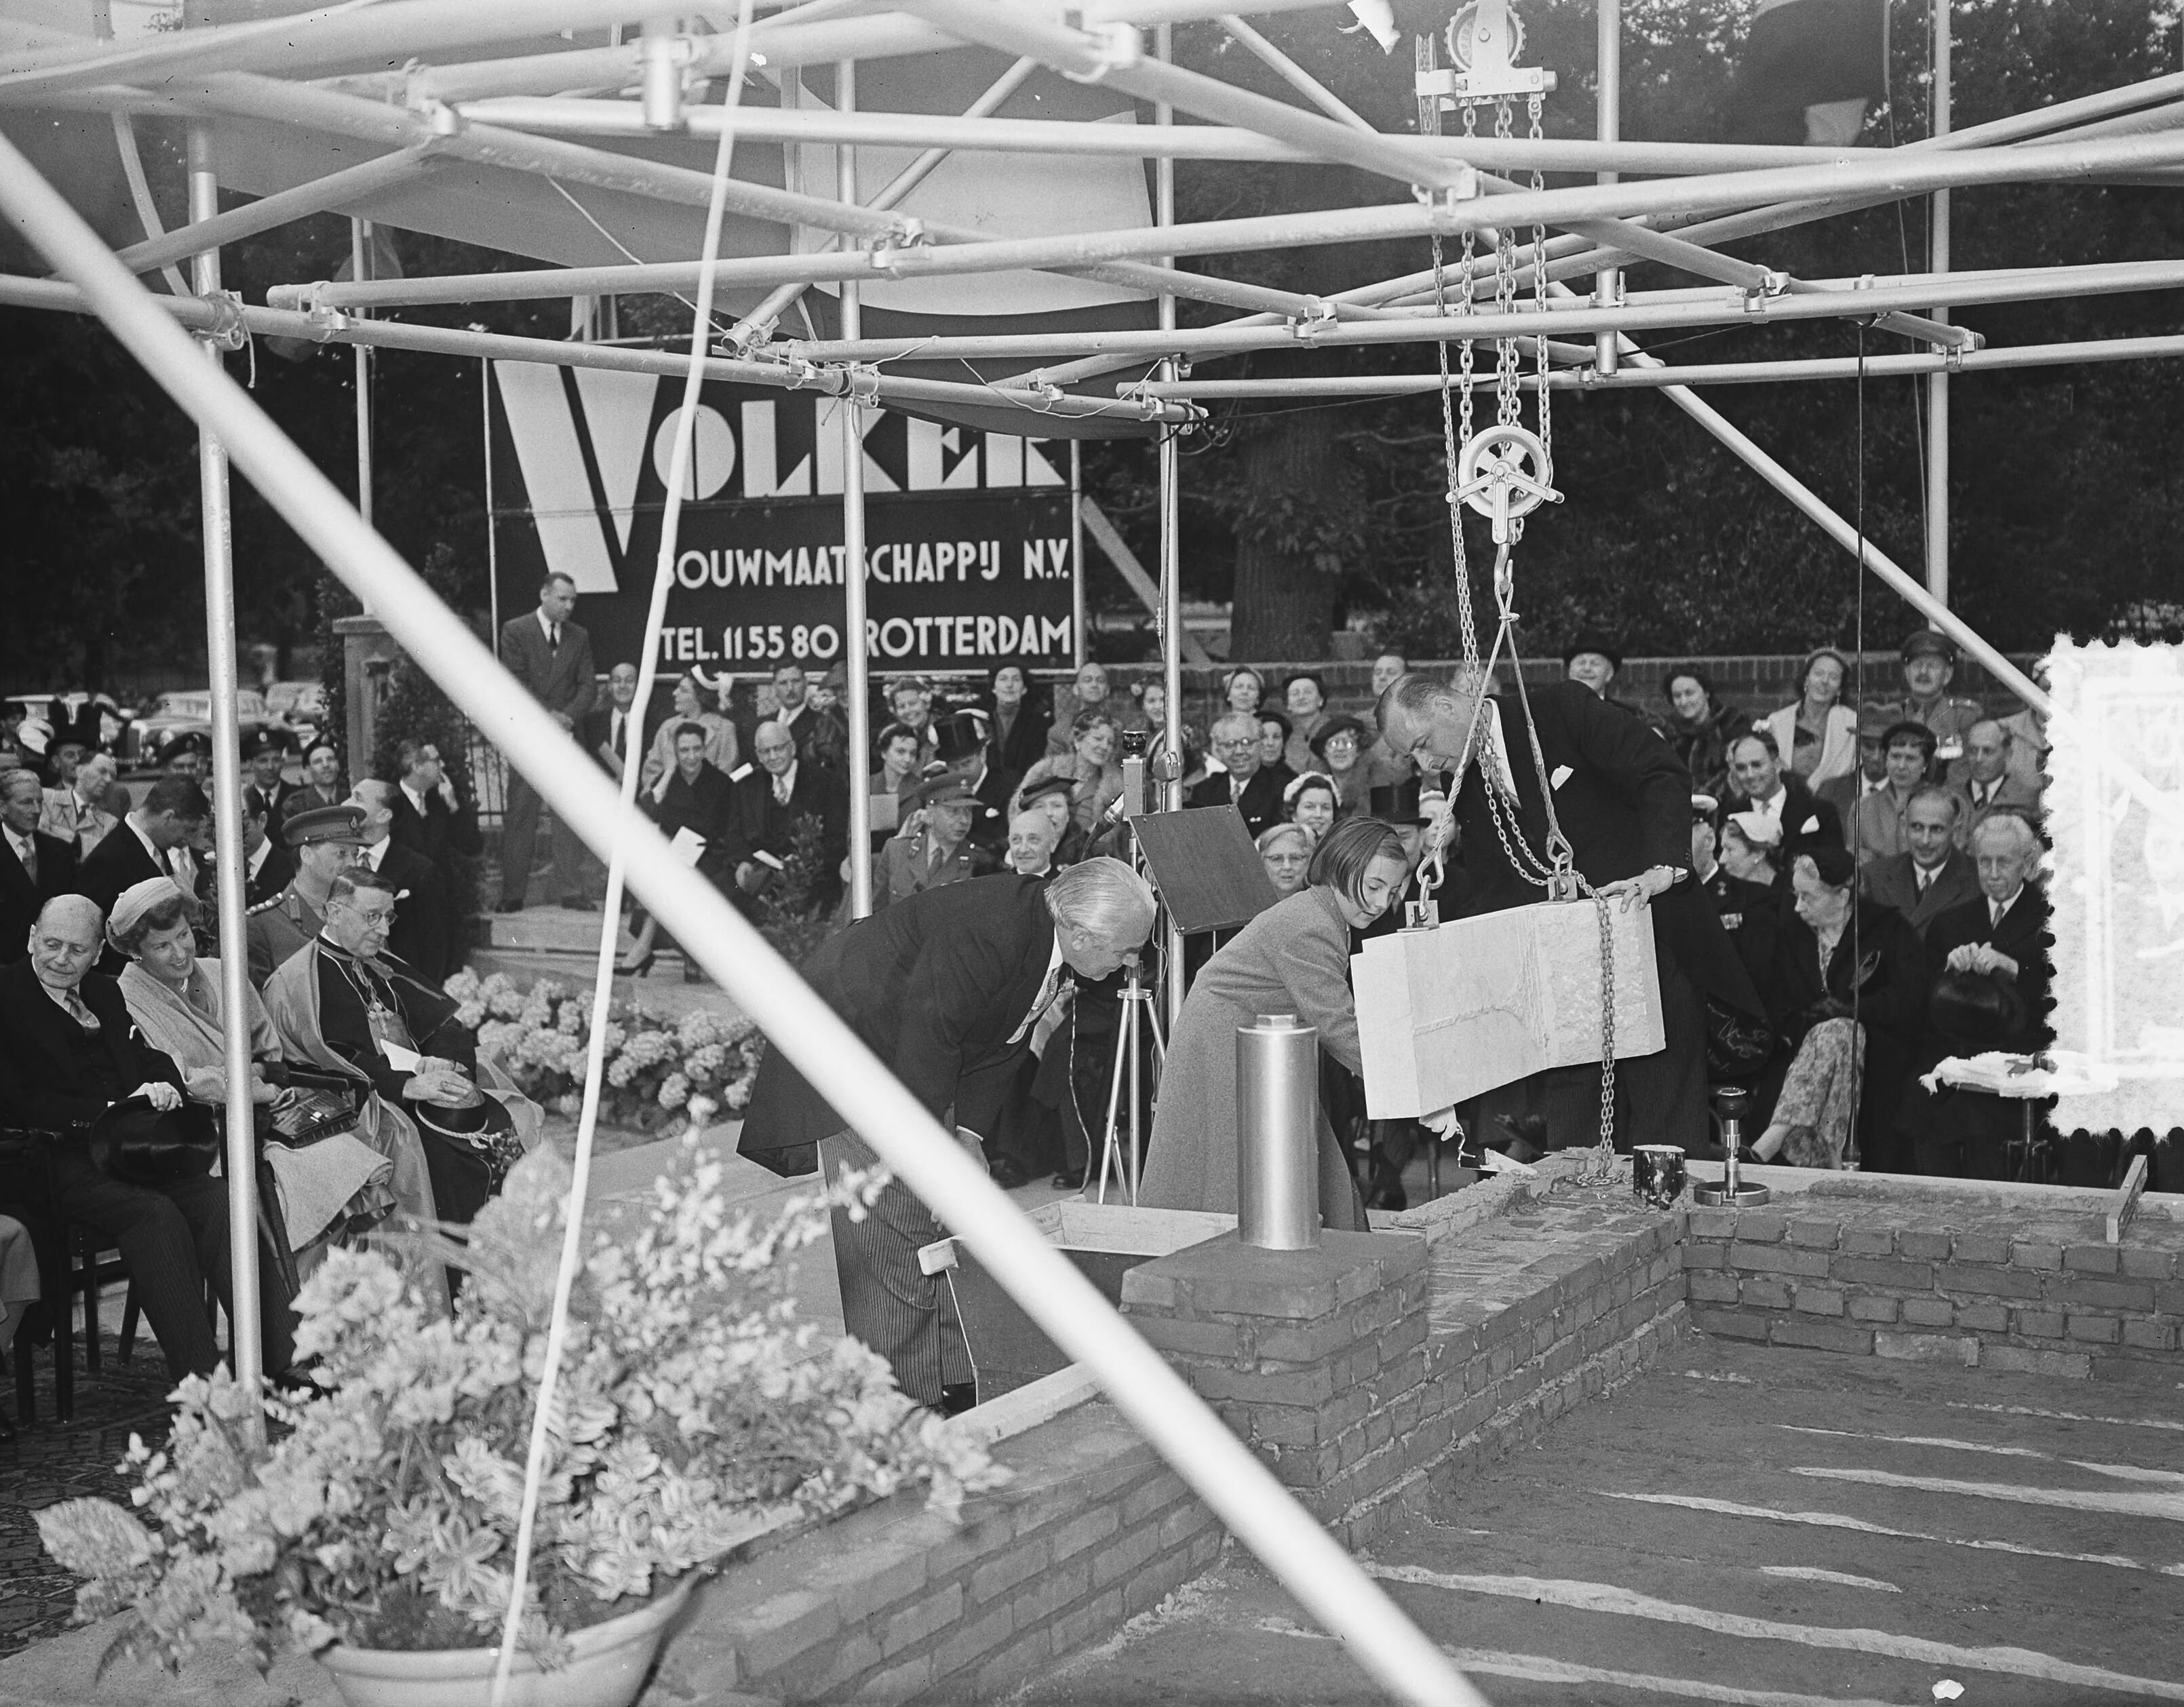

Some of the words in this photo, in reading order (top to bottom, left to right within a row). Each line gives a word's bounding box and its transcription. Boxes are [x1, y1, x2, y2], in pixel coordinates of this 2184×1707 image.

[658, 540, 1000, 589] OUWMAATCHAPPIJ
[1023, 538, 1069, 580] N.V.
[661, 627, 719, 660] TEL.
[866, 615, 1070, 657] ROTTERDAM
